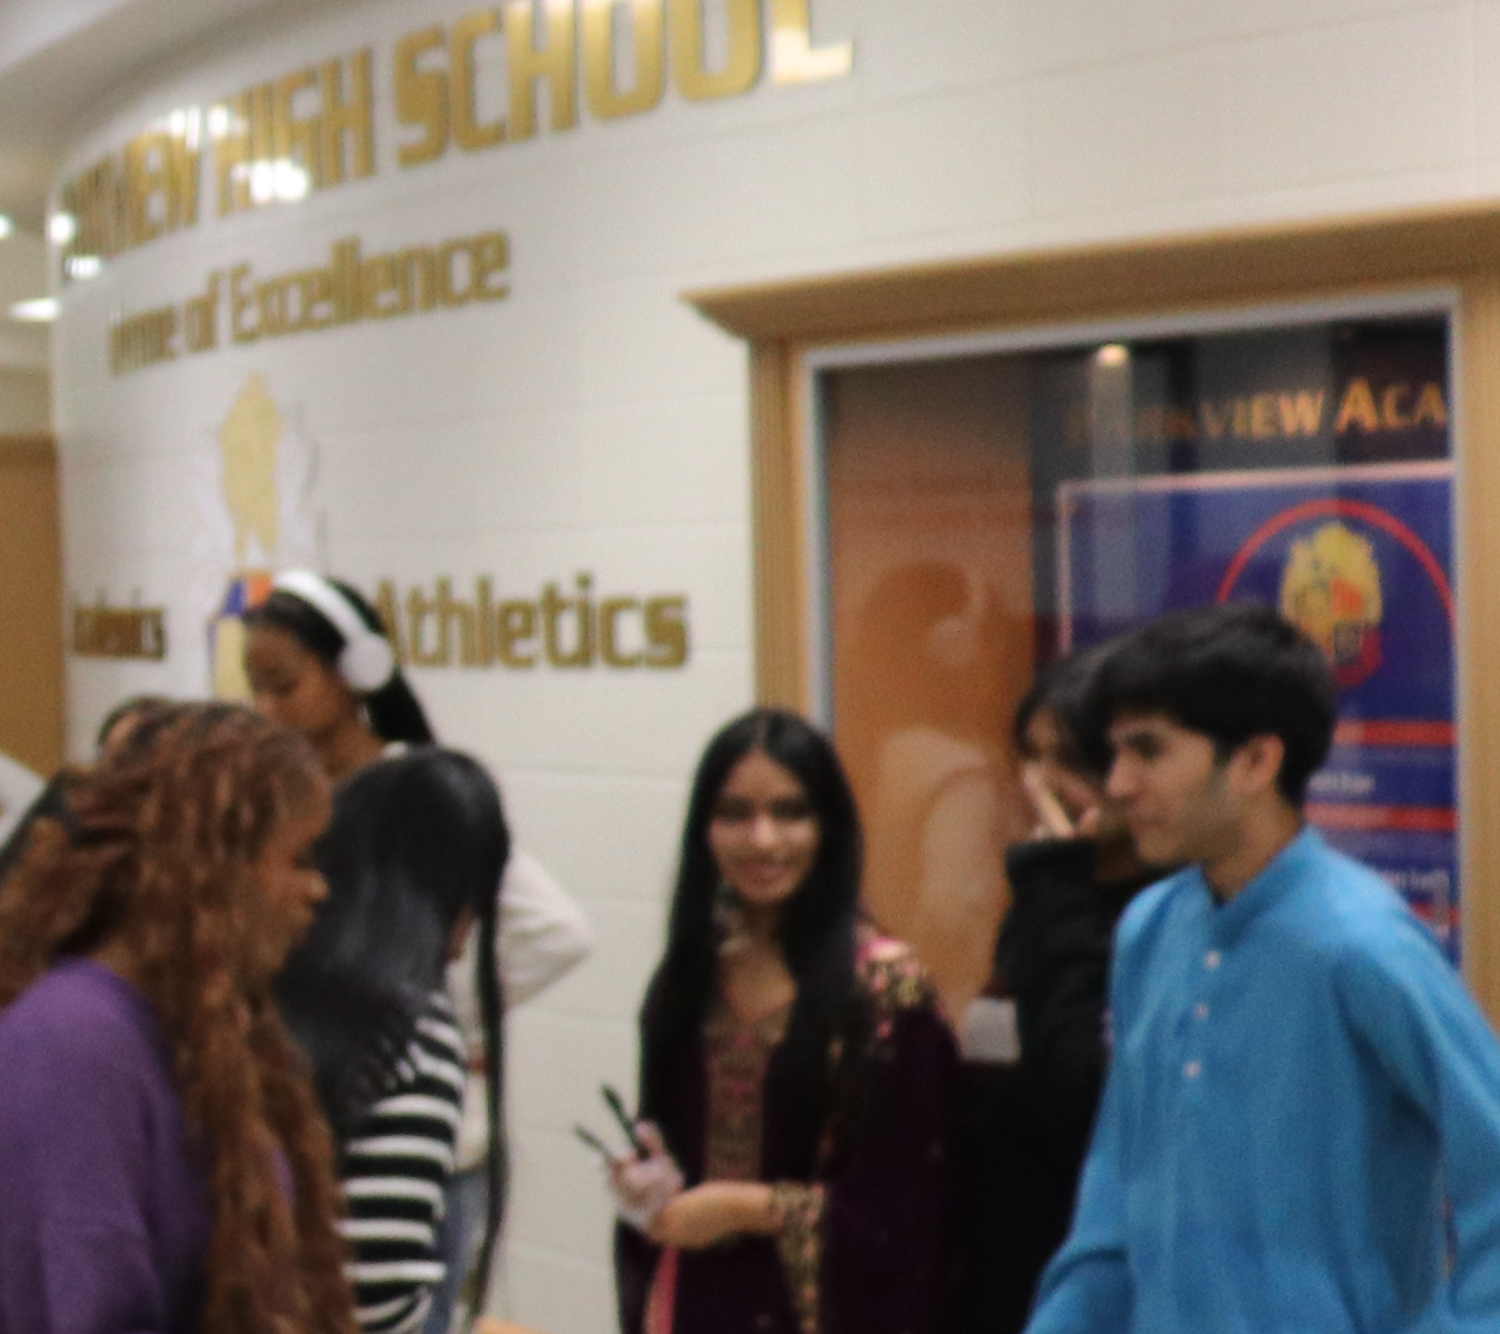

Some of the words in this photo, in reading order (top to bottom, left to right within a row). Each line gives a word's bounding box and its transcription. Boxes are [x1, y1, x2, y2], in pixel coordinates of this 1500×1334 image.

[208, 45, 378, 217] HIGH
[185, 270, 222, 355] of
[230, 229, 512, 347] Excellence
